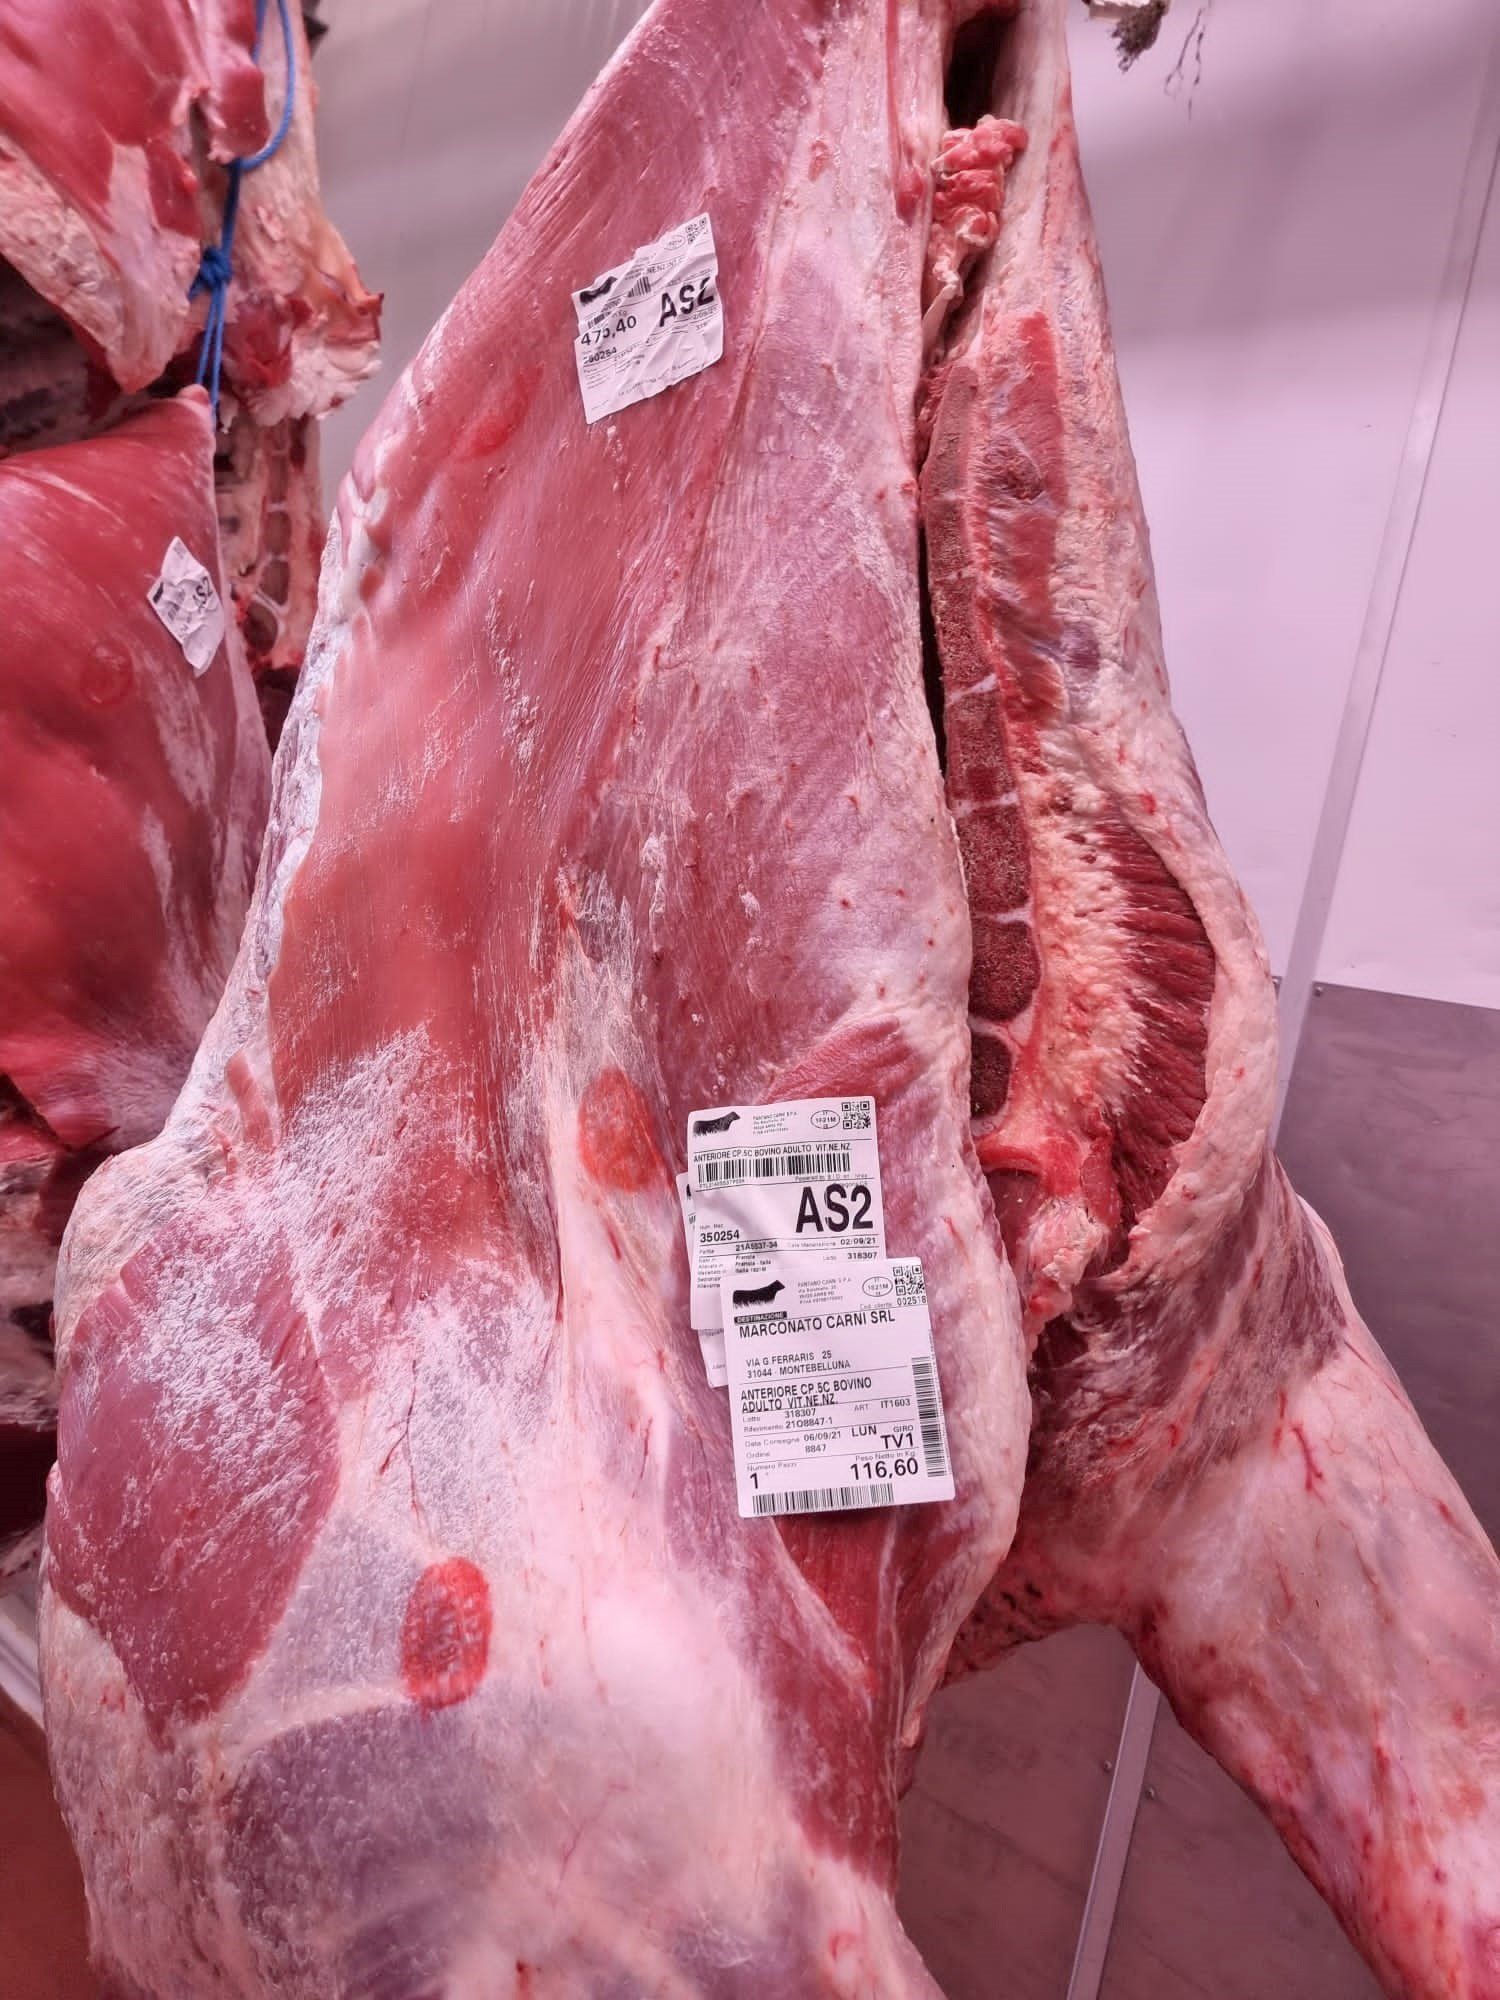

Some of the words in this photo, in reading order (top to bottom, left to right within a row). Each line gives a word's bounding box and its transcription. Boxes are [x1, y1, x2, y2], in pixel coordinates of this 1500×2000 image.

[693, 1151, 731, 1162] ANTERIORE
[754, 1146, 781, 1157] BOVINO
[783, 1144, 812, 1155] ADULTO
[795, 1183, 874, 1233] AS2
[700, 1229, 740, 1243] 350254
[847, 1251, 878, 1260] 318307
[736, 1312, 785, 1323] DESTINAZIONE
[739, 1318, 823, 1338] MARCONATO
[826, 1313, 866, 1329] CARNI
[870, 1309, 896, 1324] SRL
[745, 1358, 761, 1367] VIA
[762, 1357, 769, 1366] G
[771, 1352, 815, 1365] FERRARIS
[821, 1350, 832, 1359] 25
[746, 1368, 772, 1379] 31044
[779, 1360, 851, 1376] MONTEBELLUNA
[741, 1385, 798, 1401] ANTERIORE
[833, 1377, 872, 1392] BOVINO
[742, 1399, 782, 1413] ADULTO
[880, 1398, 911, 1409] IT1603
[784, 1408, 816, 1419] 318307
[851, 1425, 878, 1438] LUN
[892, 1425, 914, 1433] GIRO
[803, 1431, 841, 1442] 06/09/21
[880, 1432, 914, 1450] TV1
[805, 1443, 827, 1453] 8847
[874, 1452, 895, 1461] Netto
[850, 1457, 919, 1481] 116,60
[749, 1472, 759, 1489] 1
